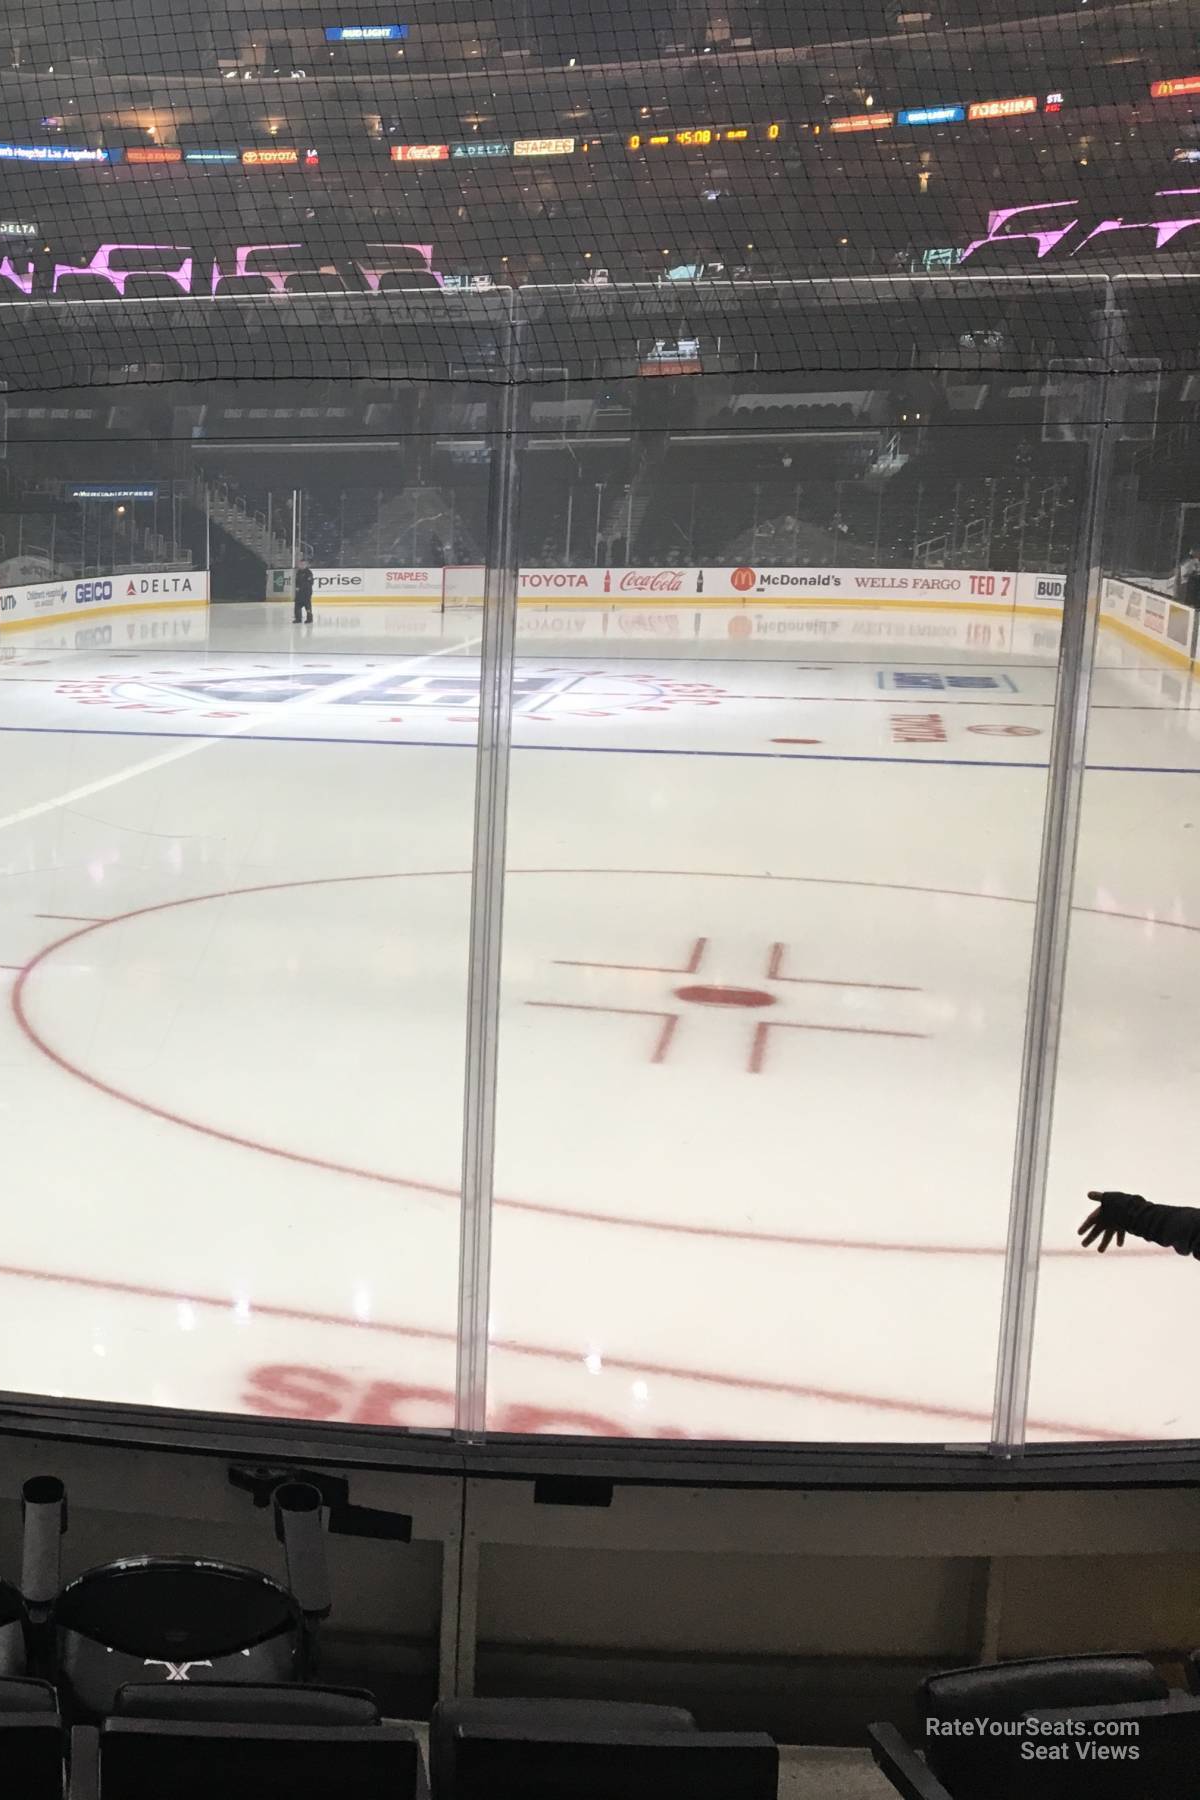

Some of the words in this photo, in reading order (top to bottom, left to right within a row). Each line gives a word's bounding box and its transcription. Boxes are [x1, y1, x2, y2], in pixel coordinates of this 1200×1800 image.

[971, 99, 1036, 118] TOSHIBA
[467, 145, 511, 156] DELTA
[515, 141, 573, 154] STAPLES
[258, 152, 298, 161] TOYOTA
[0, 222, 37, 235] DELTA
[385, 571, 429, 582] STAPLES
[519, 574, 589, 588] TOYOTA
[619, 570, 688, 592] Coca-Cola
[759, 574, 841, 587] McDonald's
[140, 578, 192, 594] DELTA
[854, 577, 909, 589] WELLS
[911, 578, 961, 591] FARGO
[969, 575, 996, 596] TED
[1037, 582, 1062, 597] BUD
[75, 581, 113, 604] GEICO
